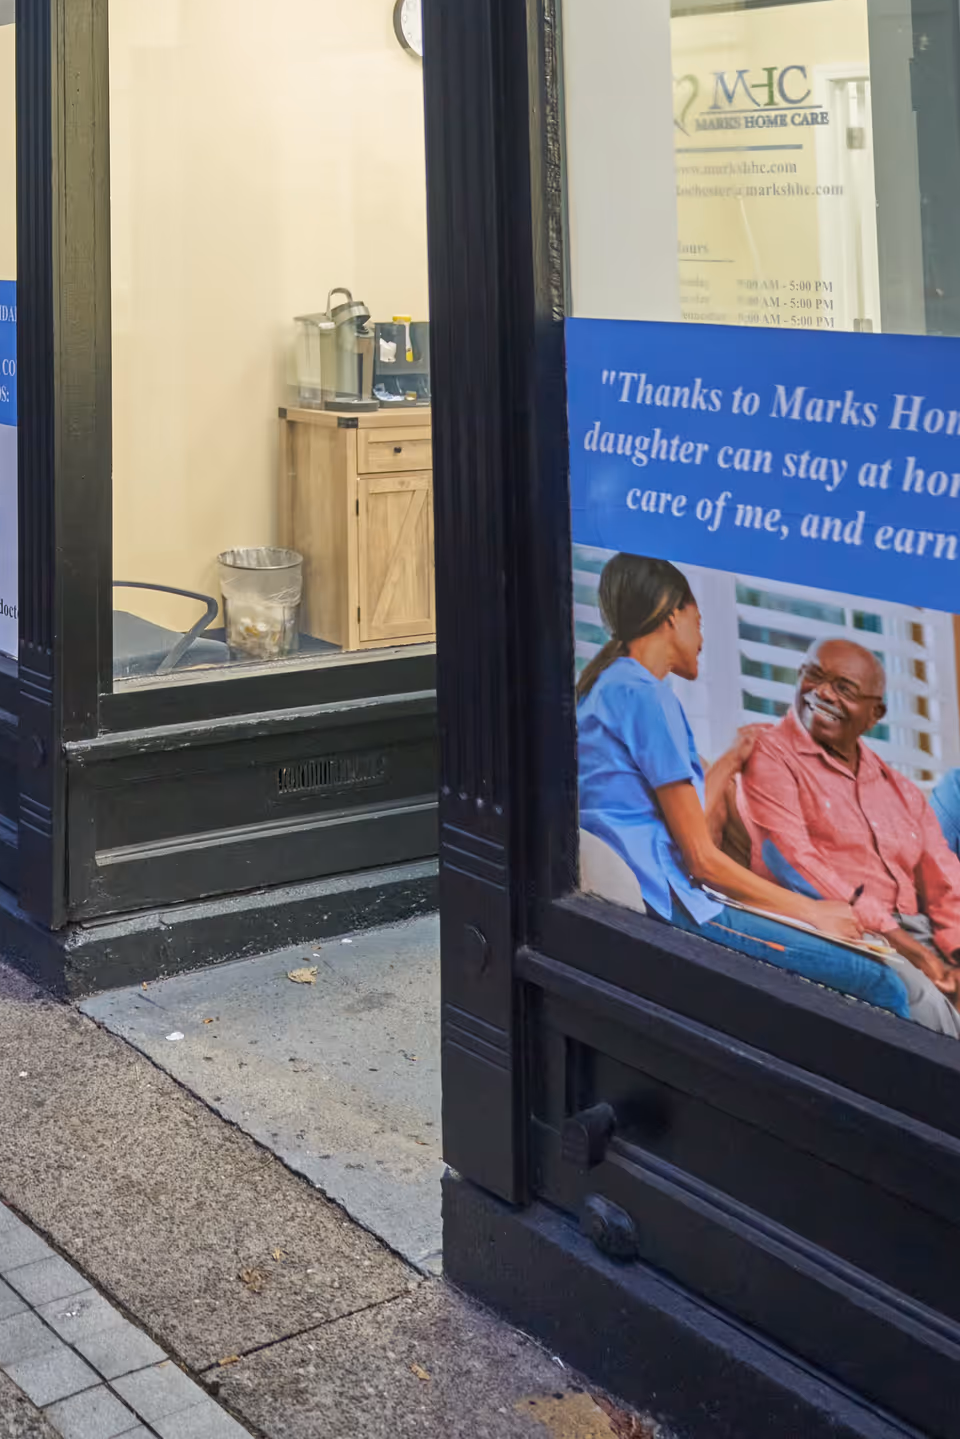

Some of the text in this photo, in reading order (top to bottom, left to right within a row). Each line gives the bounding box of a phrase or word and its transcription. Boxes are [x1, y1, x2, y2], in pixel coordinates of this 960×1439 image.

[709, 65, 811, 109] MHC
[695, 112, 829, 131] MARKS HOME CARE
[790, 280, 811, 292] 5:00
[815, 281, 833, 293] PM
[761, 296, 780, 308] AM
[790, 298, 812, 309] 5:00
[815, 299, 833, 310] PM
[761, 314, 780, 325] AM
[791, 315, 812, 327] 5:00
[816, 316, 834, 328] PM
[601, 370, 722, 412] "Thanks
[731, 386, 761, 416] to
[769, 384, 878, 428] Marks
[583, 421, 709, 467] daughter
[717, 445, 773, 474] can
[782, 450, 848, 492] stay
[858, 459, 892, 490] at
[626, 487, 958, 560] care of me, and earn
